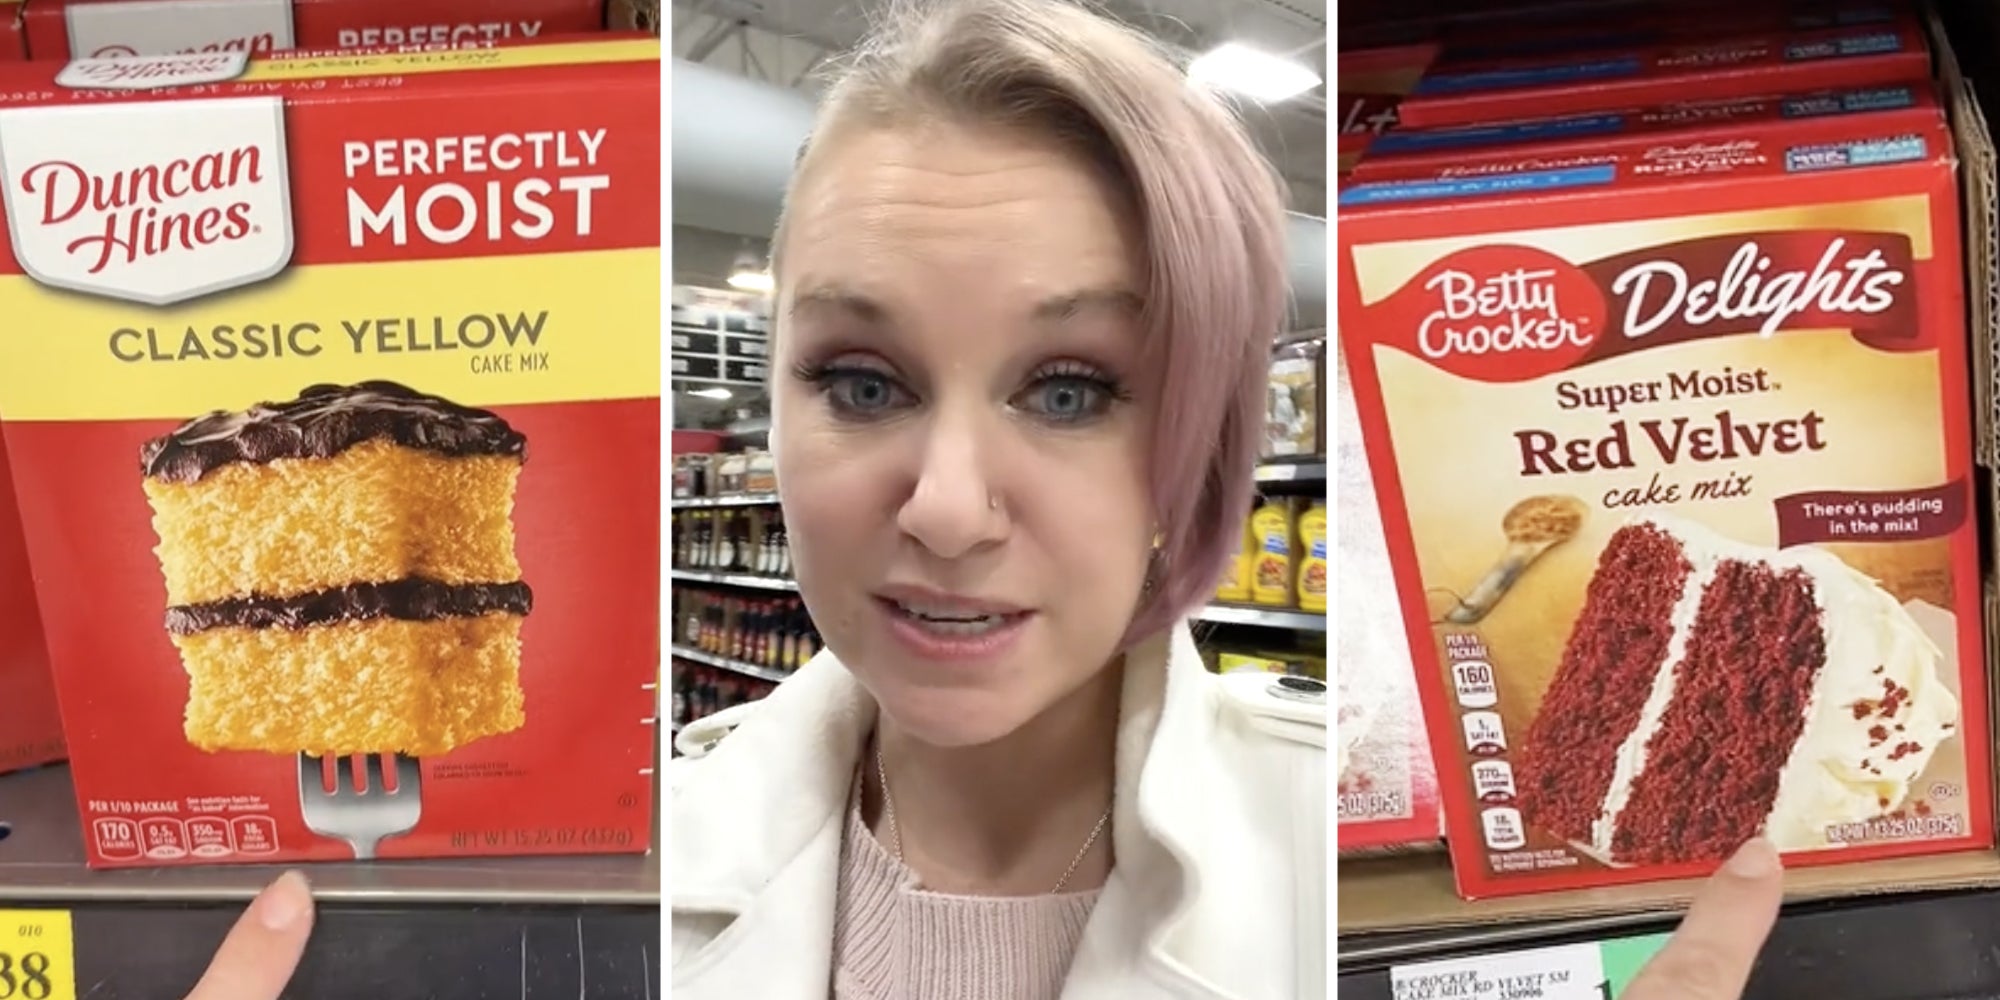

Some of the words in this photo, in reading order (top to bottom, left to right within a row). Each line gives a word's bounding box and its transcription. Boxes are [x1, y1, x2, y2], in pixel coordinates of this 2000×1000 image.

[344, 129, 608, 178] PERFECTLY
[21, 145, 263, 225] Duncan
[346, 175, 610, 248] MOIST
[66, 202, 252, 274] Hines
[1426, 267, 1556, 319] Betty
[1612, 238, 1904, 339] Delights
[109, 322, 323, 363] CLASSIC
[341, 311, 549, 354] YELLOW
[1418, 313, 1593, 360] Crocker
[470, 354, 513, 375] CAKE
[520, 352, 550, 373] MIX
[1556, 379, 1662, 414] Super
[1667, 367, 1769, 401] Moist
[1513, 420, 1637, 477] Red
[1639, 410, 1828, 466] Velvet
[1603, 473, 1682, 509] cake
[1691, 471, 1753, 501] mix
[1802, 501, 1868, 519] There's
[1872, 497, 1944, 518] pudding
[1829, 520, 1847, 535] in
[1850, 519, 1880, 534] the
[1884, 517, 1920, 533] mix!
[1457, 665, 1490, 685] 160
[89, 800, 108, 812] PER
[133, 800, 179, 813] PACKAGE
[101, 822, 131, 841] 170
[452, 832, 477, 848] NET
[485, 830, 508, 846] WT
[18, 925, 43, 937] 010
